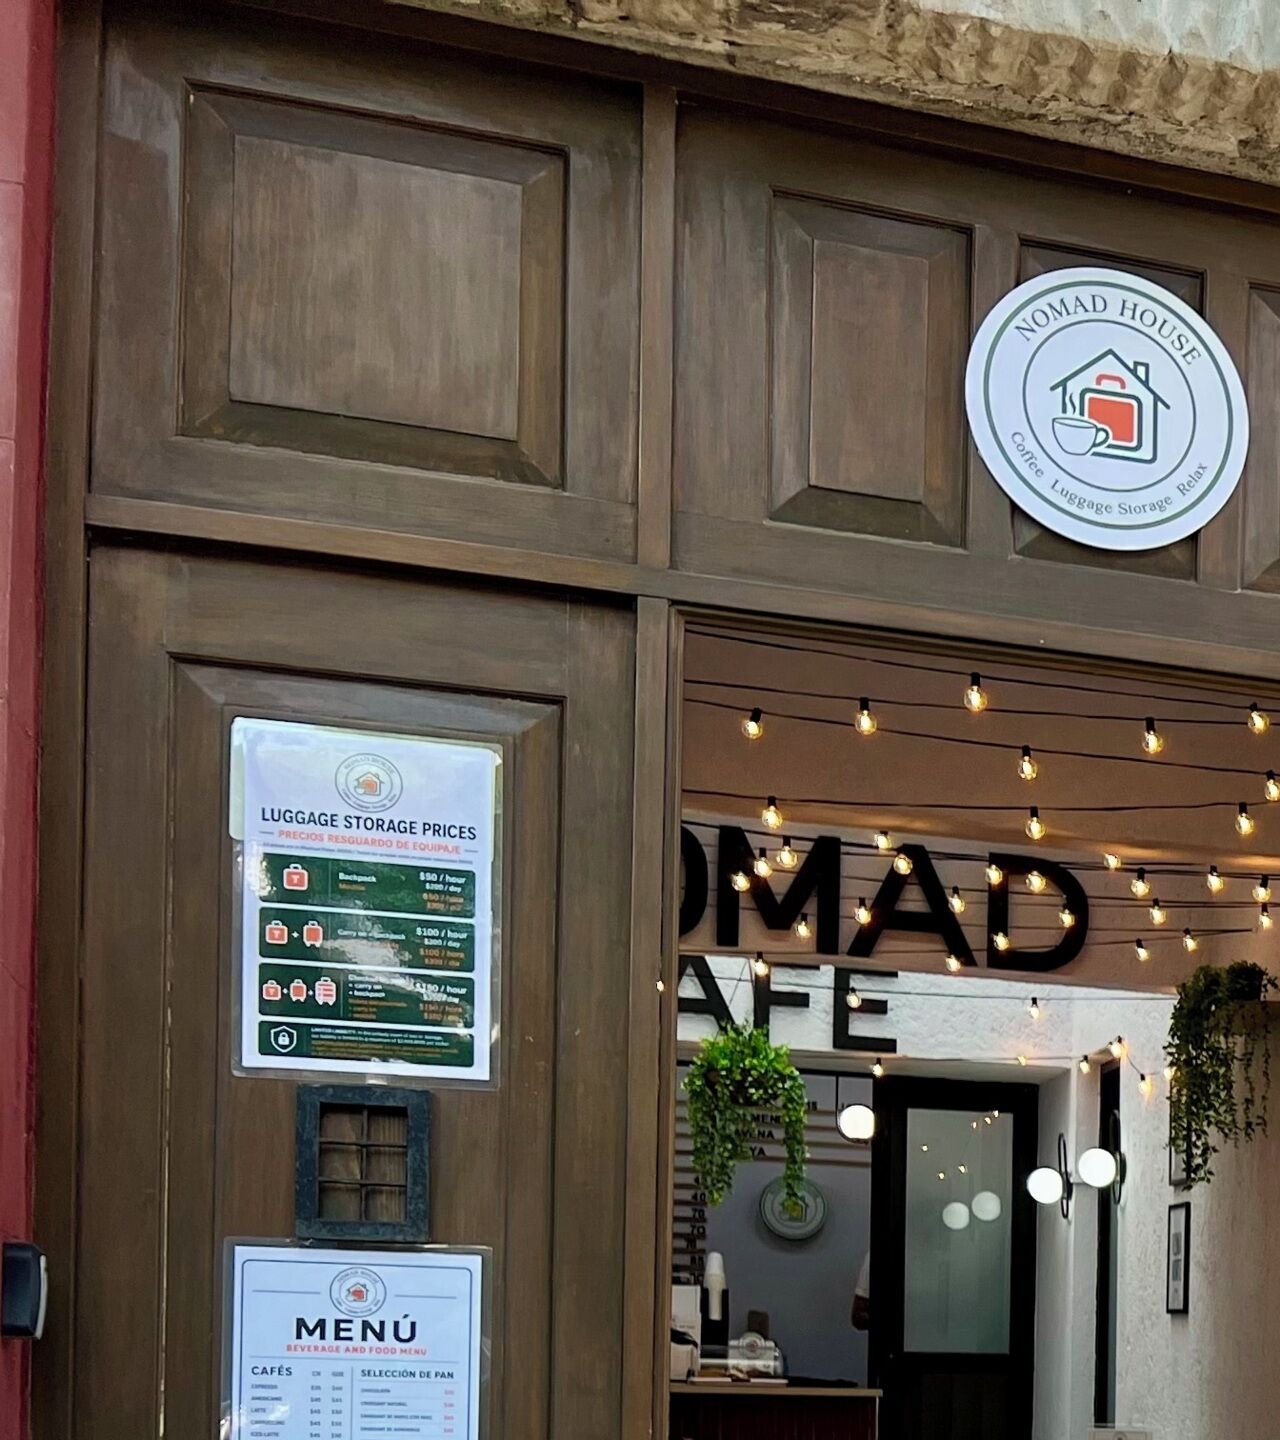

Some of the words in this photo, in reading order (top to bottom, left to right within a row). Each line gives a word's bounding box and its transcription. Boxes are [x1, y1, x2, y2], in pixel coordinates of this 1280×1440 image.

[1014, 294, 1108, 342] NOMAD
[1119, 298, 1202, 366] HOUSE
[1011, 431, 1044, 478] Coffee
[1051, 478, 1113, 515] Luggage
[1118, 494, 1173, 515] Storage
[1176, 462, 1208, 497] Relax
[261, 807, 338, 828] LUGGAGE
[344, 815, 418, 835] STORAGE
[422, 822, 477, 841] PRICES
[278, 830, 324, 843] PRECIOS
[328, 834, 393, 849] RESGUARDO
[397, 840, 410, 850] DE
[413, 842, 462, 855] EQUIPAJE
[295, 1314, 417, 1343] MENÚ
[287, 1345, 341, 1354] BEVERAGE
[344, 1346, 366, 1354] AND
[369, 1346, 397, 1355] FOOD
[400, 1347, 427, 1356] MENU
[251, 1364, 293, 1376] CAFÉS
[361, 1368, 416, 1378] SELECCIÓN
[420, 1371, 432, 1379] DE
[435, 1371, 454, 1379] PAN
